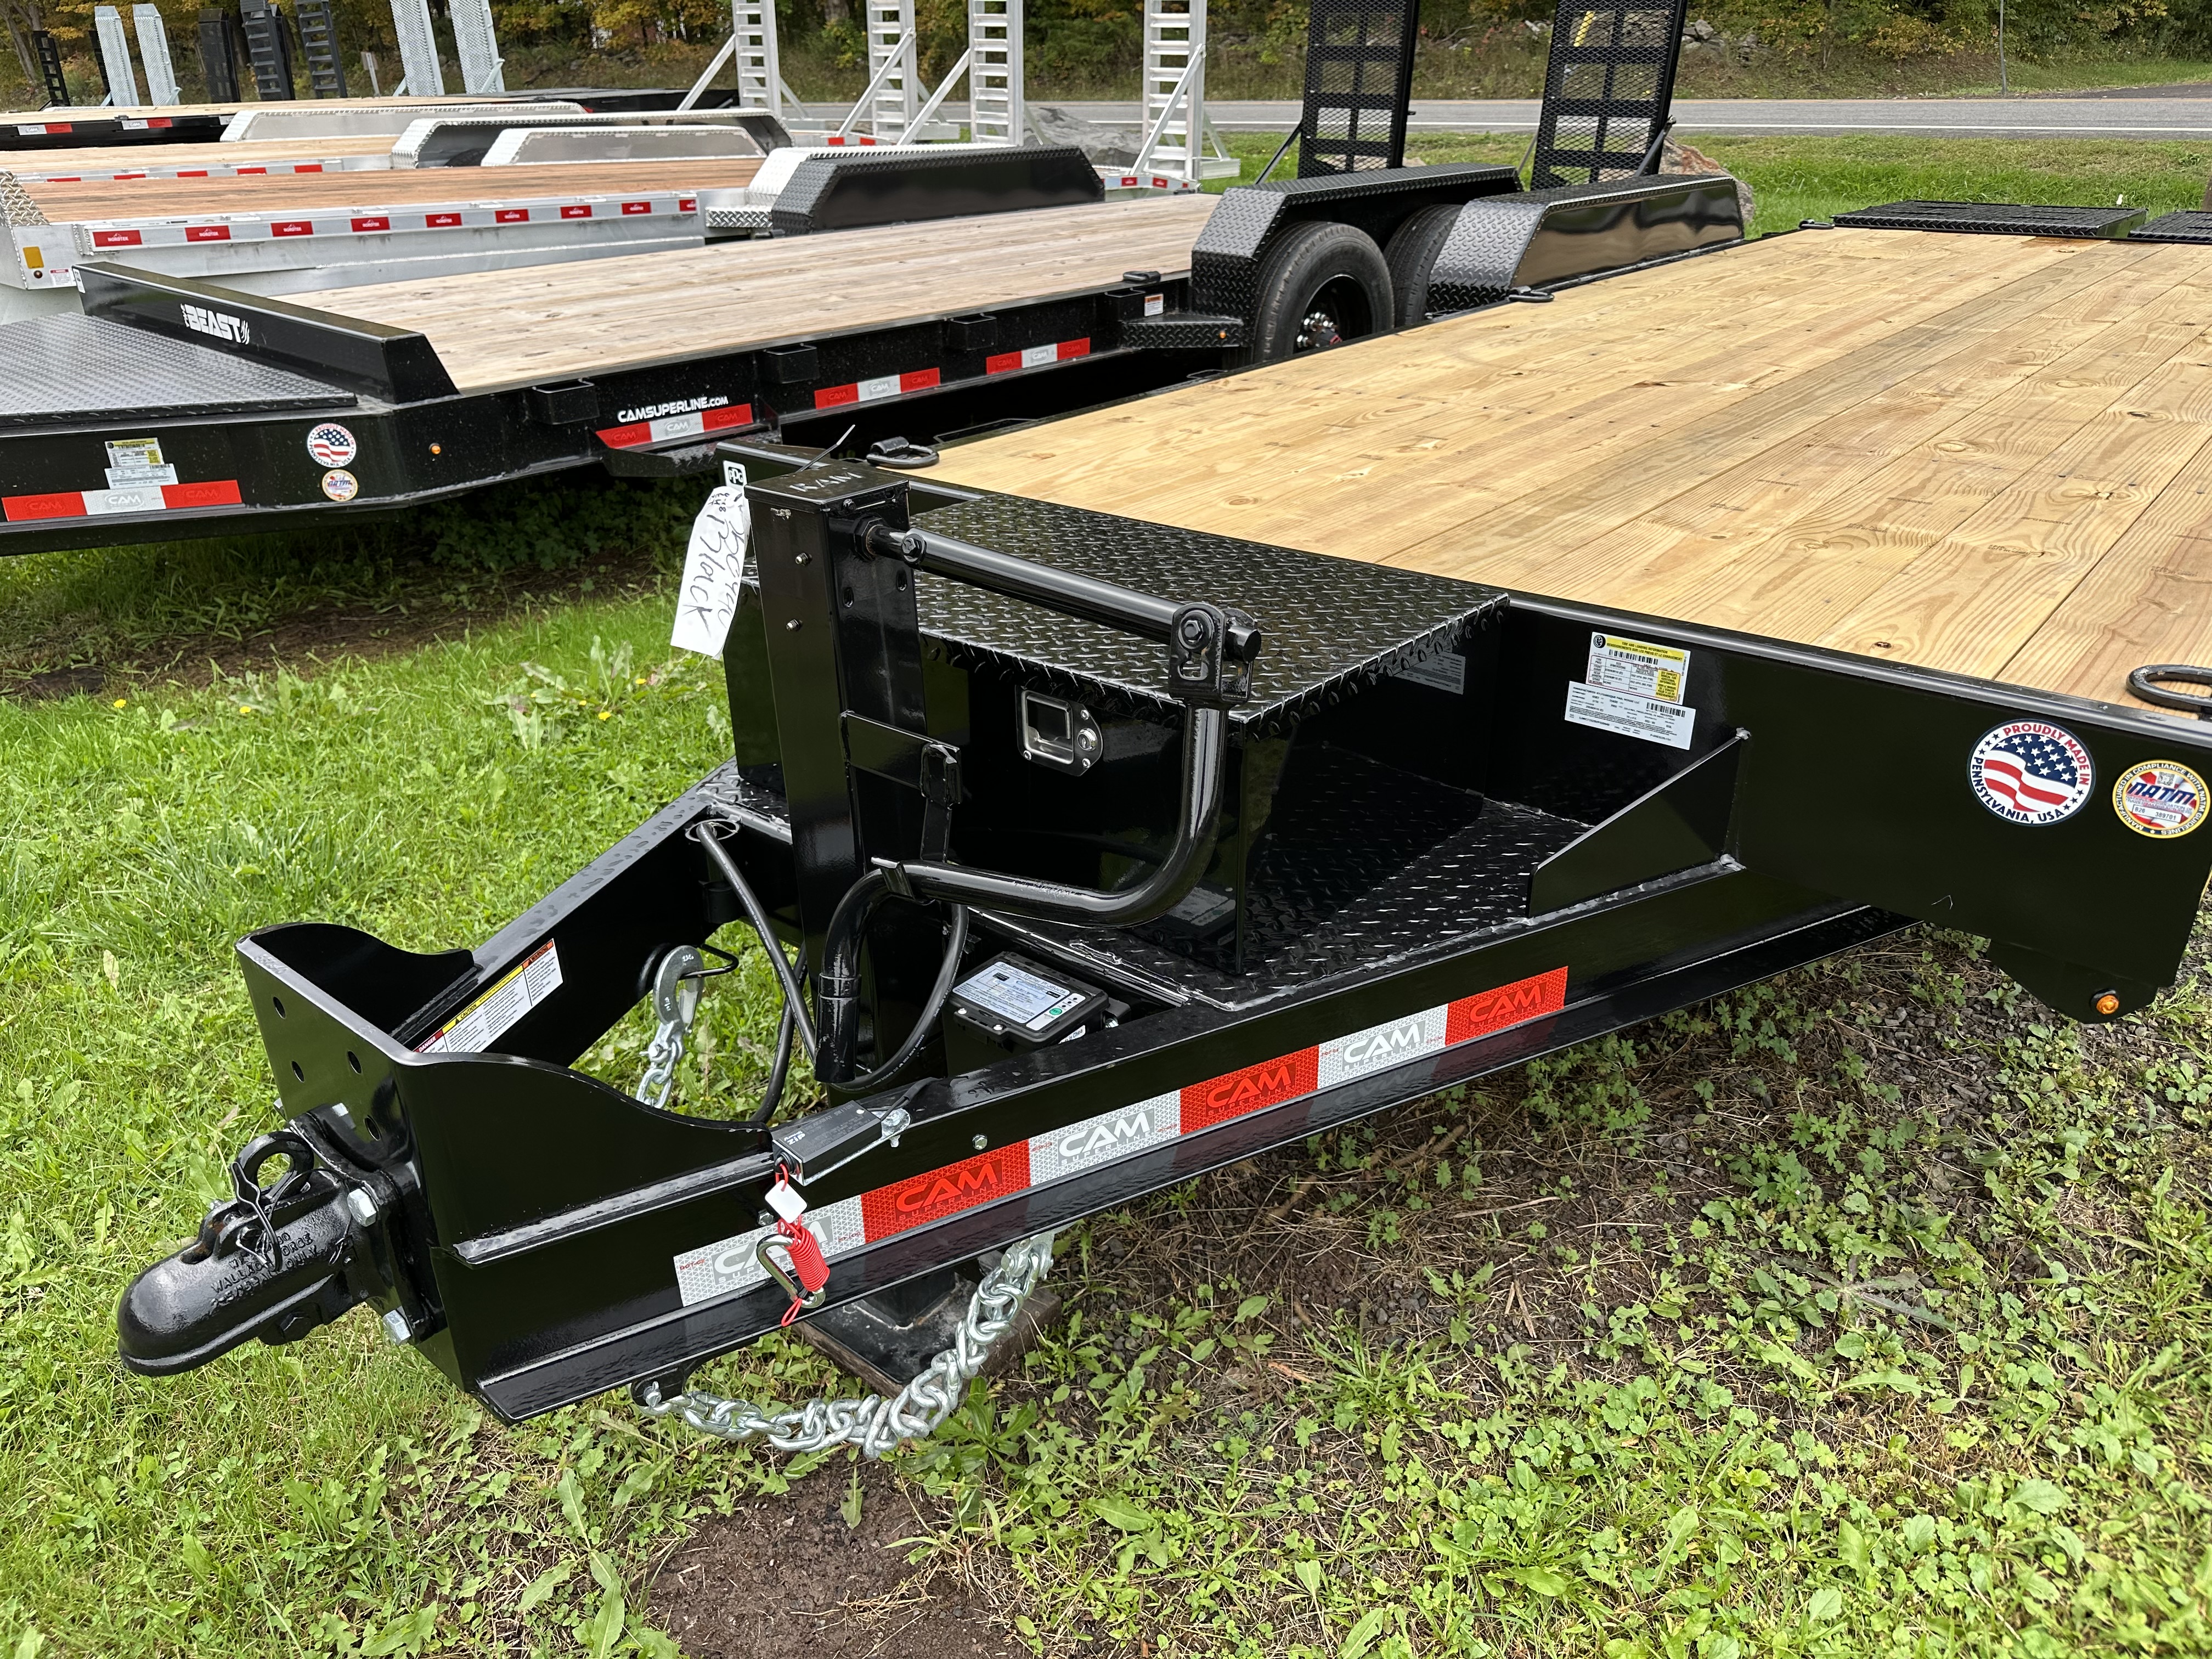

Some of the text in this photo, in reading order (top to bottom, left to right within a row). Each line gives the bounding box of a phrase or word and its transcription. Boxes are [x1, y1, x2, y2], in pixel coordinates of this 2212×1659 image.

[184, 303, 241, 343] BEAST
[828, 391, 847, 400] CAM
[871, 383, 889, 392] CAM
[666, 421, 689, 431] CAM
[717, 413, 738, 422] CAM
[613, 431, 636, 441] CAM
[729, 467, 744, 485] PPG
[108, 494, 142, 504] CAM
[184, 489, 219, 499] CAM
[28, 501, 63, 511] CAM
[2003, 723, 2090, 786] PROUDLY MADE IN
[2132, 763, 2187, 775] COMPLIANCE
[2186, 772, 2200, 789] WITH
[1972, 757, 2066, 824] PENNSYLVANIA, USA
[2116, 781, 2144, 831] MANUFACTURED
[2160, 814, 2202, 835] GUIDELINES
[999, 963, 1066, 994] Superior Trailer Products
[460, 1003, 477, 1019] CAUTION
[1470, 985, 1542, 1023] CAM
[1073, 1029, 1083, 1038] China
[419, 1036, 436, 1053] DANGER
[1344, 1023, 1420, 1063] CAM
[1206, 1066, 1291, 1108] CAM
[1059, 1112, 1150, 1158] CAM
[896, 1163, 998, 1212] CAM
